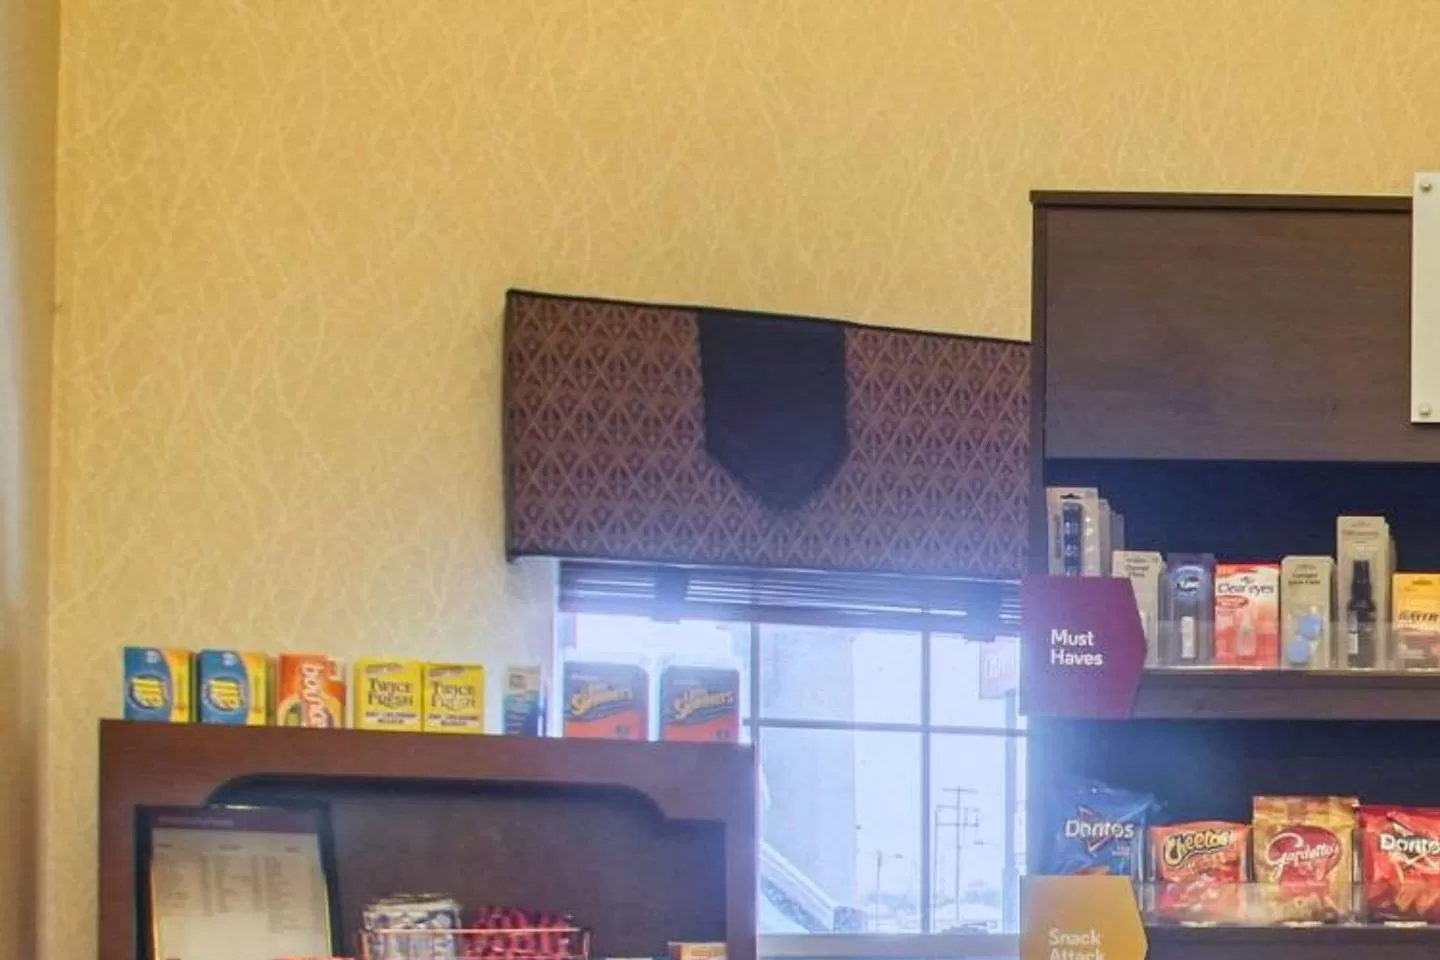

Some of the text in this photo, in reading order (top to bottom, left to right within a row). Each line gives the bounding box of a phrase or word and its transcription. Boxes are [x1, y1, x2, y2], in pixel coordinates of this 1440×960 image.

[1217, 582, 1274, 597] Clear eyes
[1050, 628, 1095, 646] Must
[1050, 649, 1103, 666] Haves
[1065, 819, 1135, 839] Doritos
[1048, 928, 1103, 946] Snack
